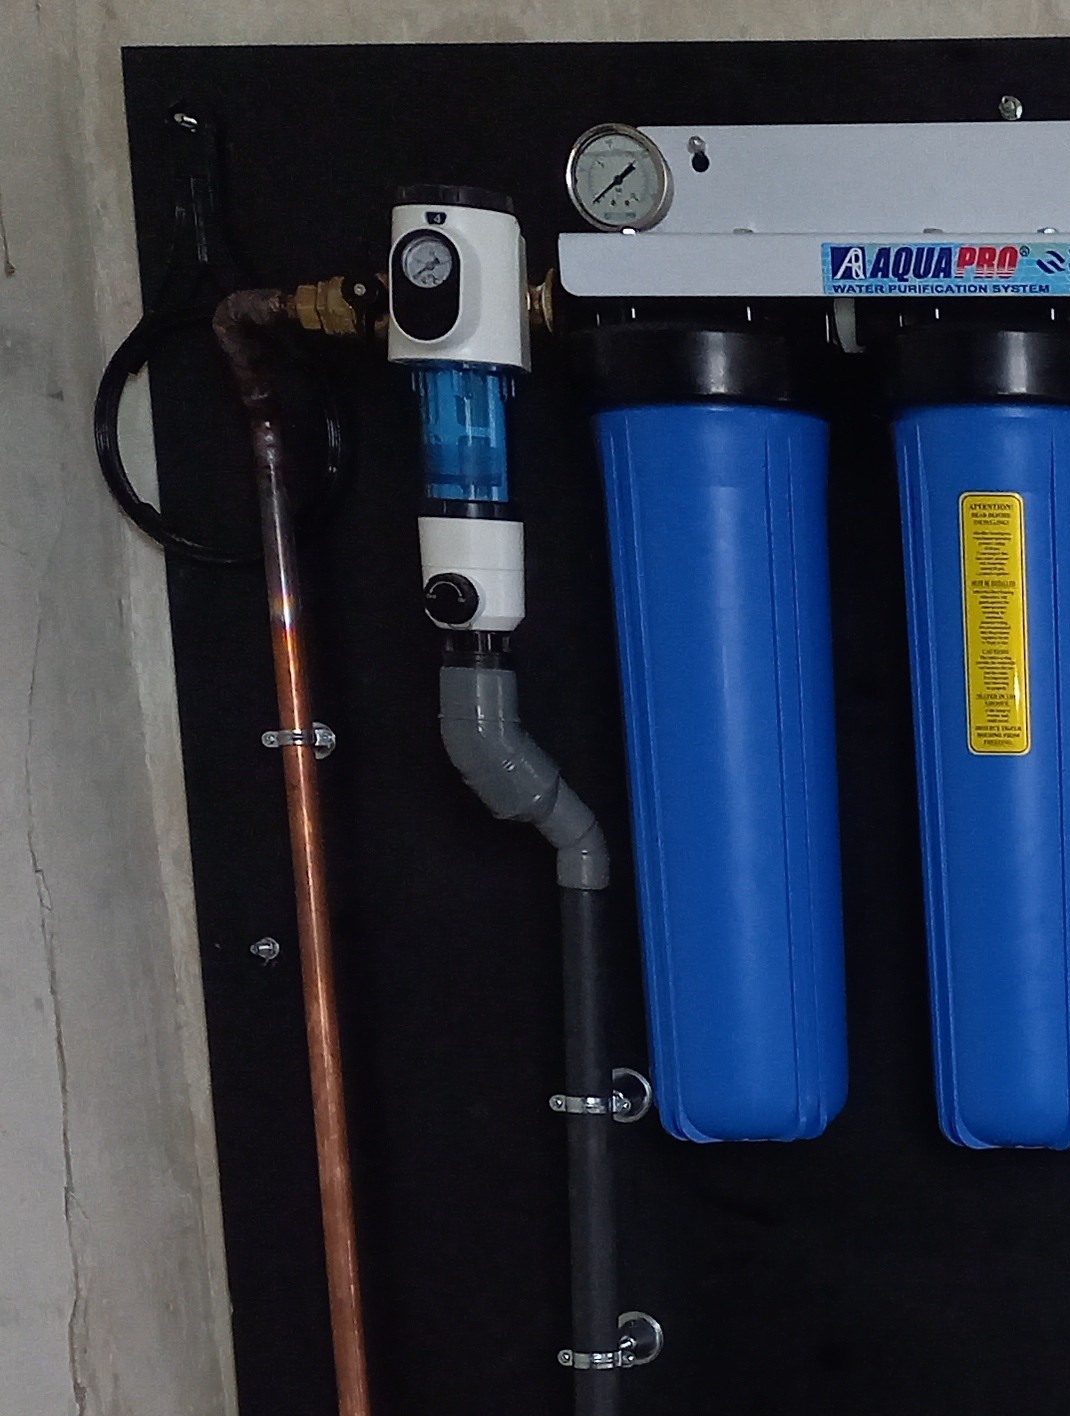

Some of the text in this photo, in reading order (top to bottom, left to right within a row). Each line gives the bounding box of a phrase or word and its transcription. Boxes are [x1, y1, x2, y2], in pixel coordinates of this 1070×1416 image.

[833, 284, 1050, 294] WATER PURIFICATION SYSTEM
